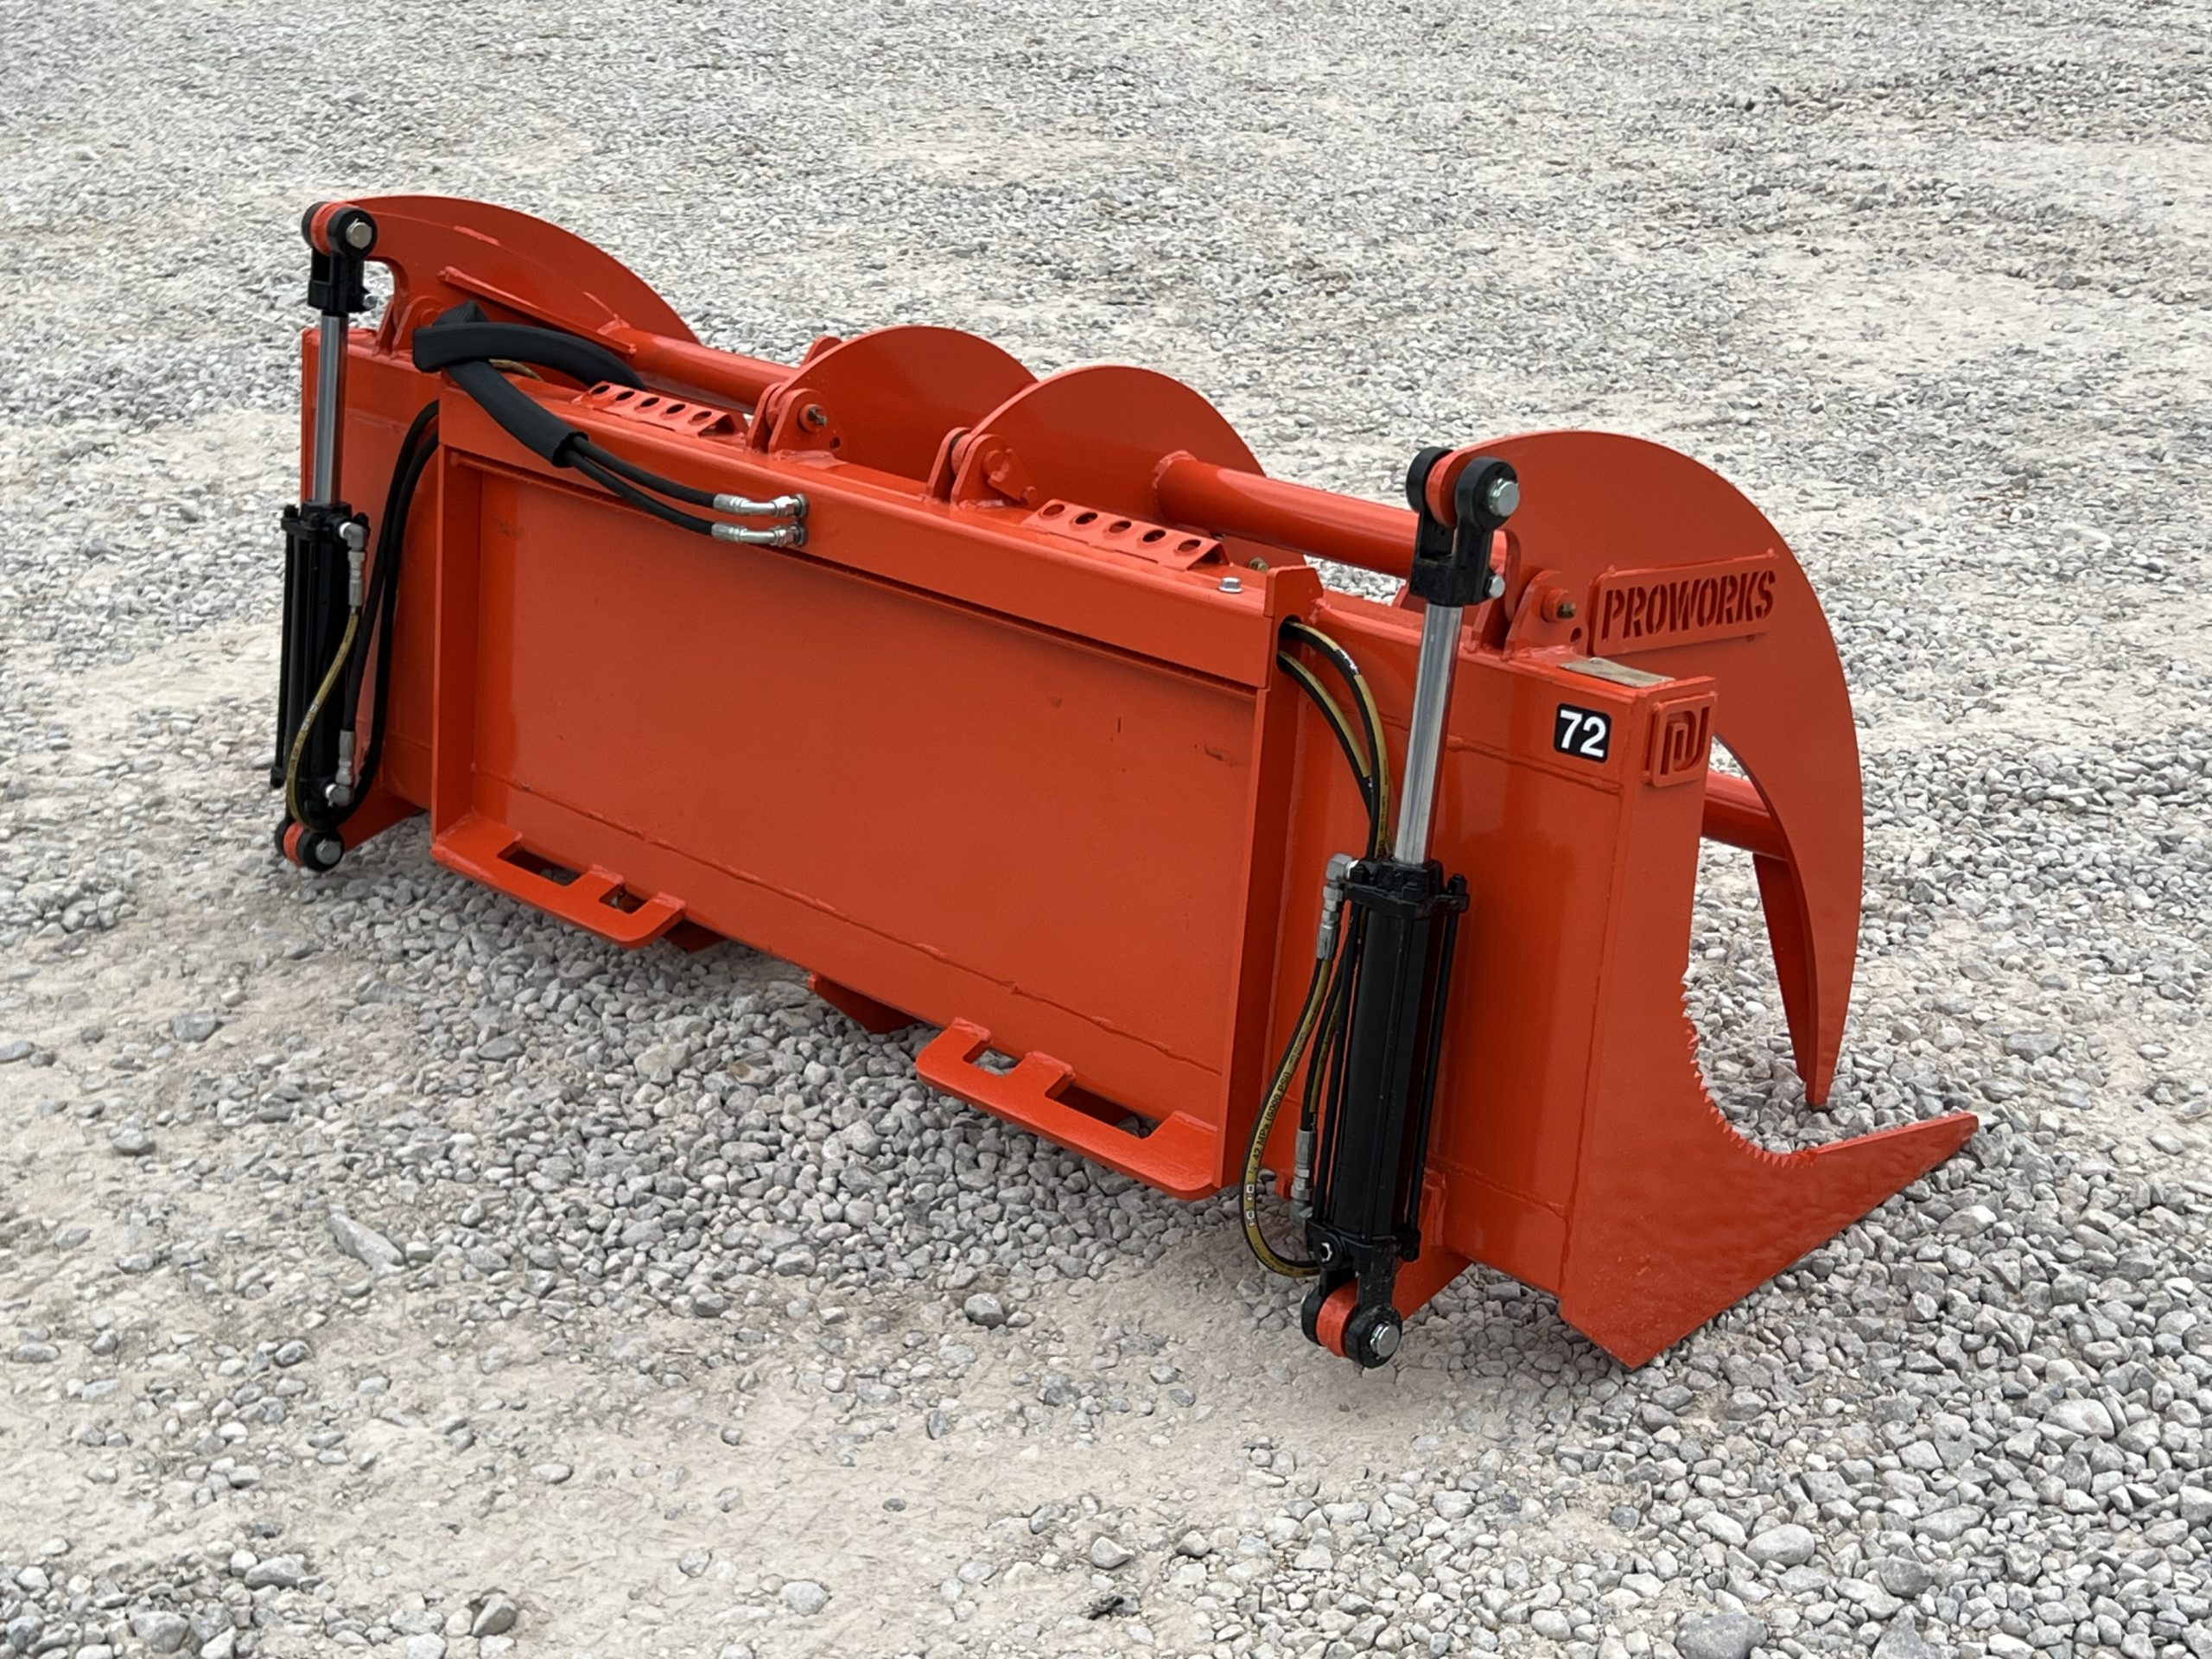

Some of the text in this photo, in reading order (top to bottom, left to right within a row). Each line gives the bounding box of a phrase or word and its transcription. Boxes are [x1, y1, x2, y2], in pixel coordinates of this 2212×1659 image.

[1601, 570, 1776, 642] PROWORKS
[1560, 709, 1607, 758] 72
[1256, 1124, 1269, 1146] MPa
[1252, 1147, 1262, 1160] 42
